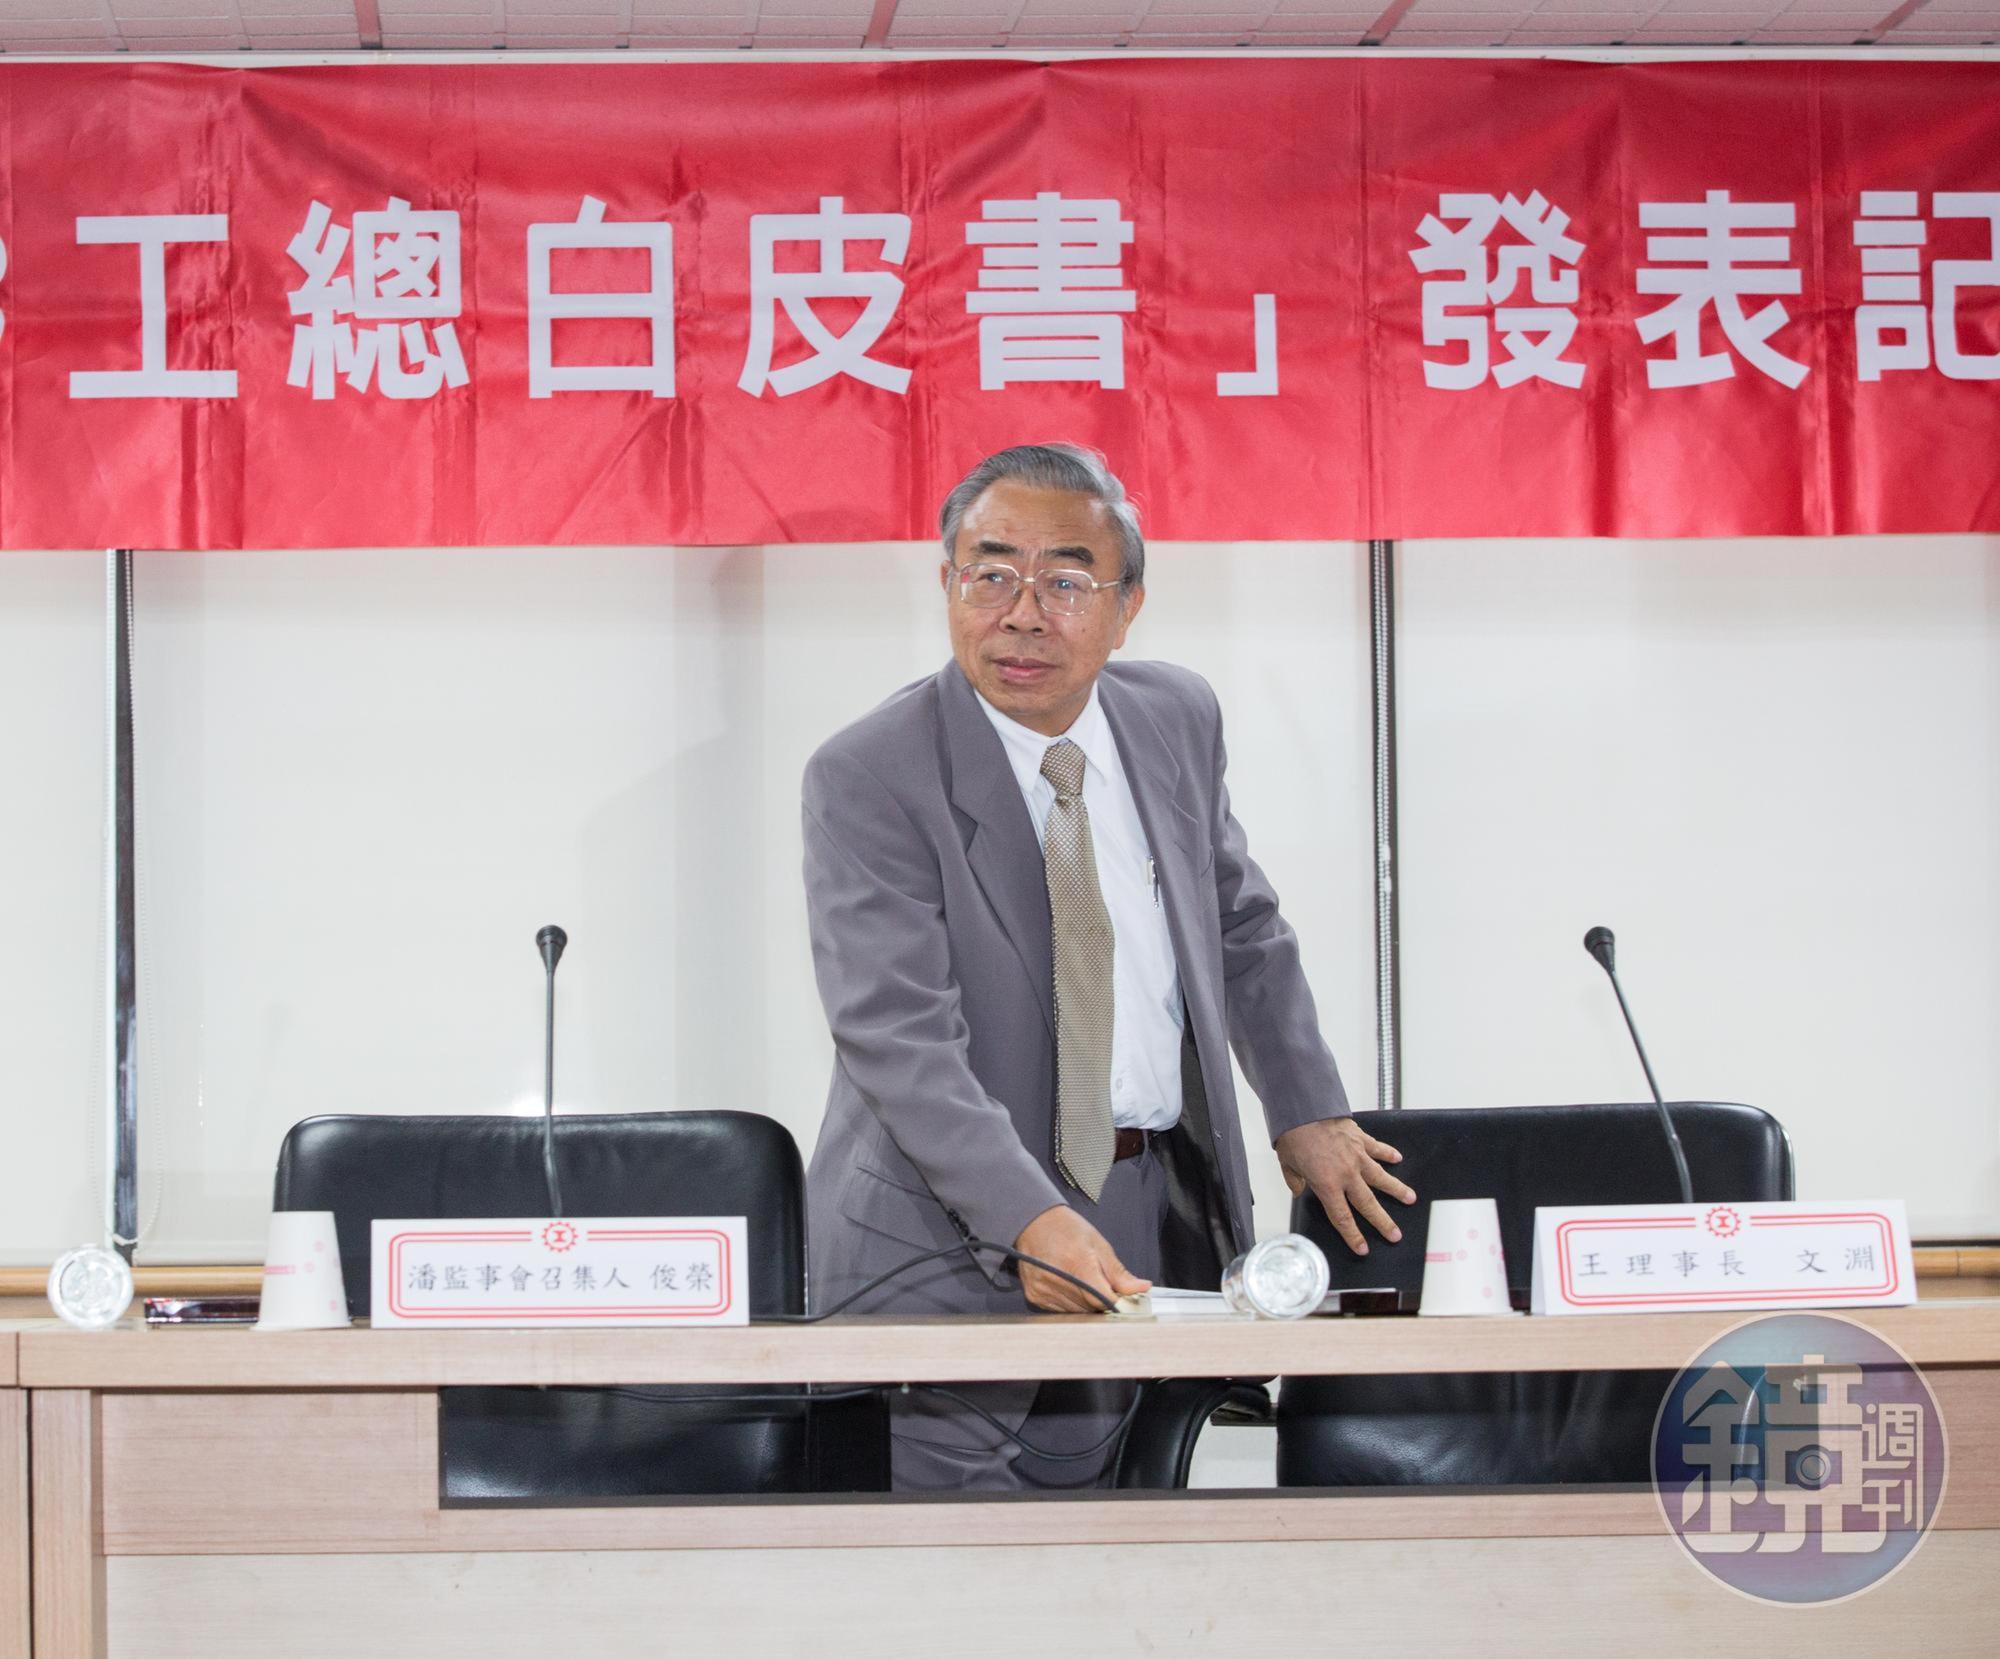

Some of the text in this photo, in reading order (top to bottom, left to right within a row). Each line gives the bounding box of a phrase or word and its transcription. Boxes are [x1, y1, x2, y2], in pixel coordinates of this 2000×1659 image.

[0, 189, 2000, 400] 工總白皮書」發表記
[408, 1262, 714, 1292] 潘監事會召集人 俊榮
[1577, 1249, 1747, 1278] 王理事長
